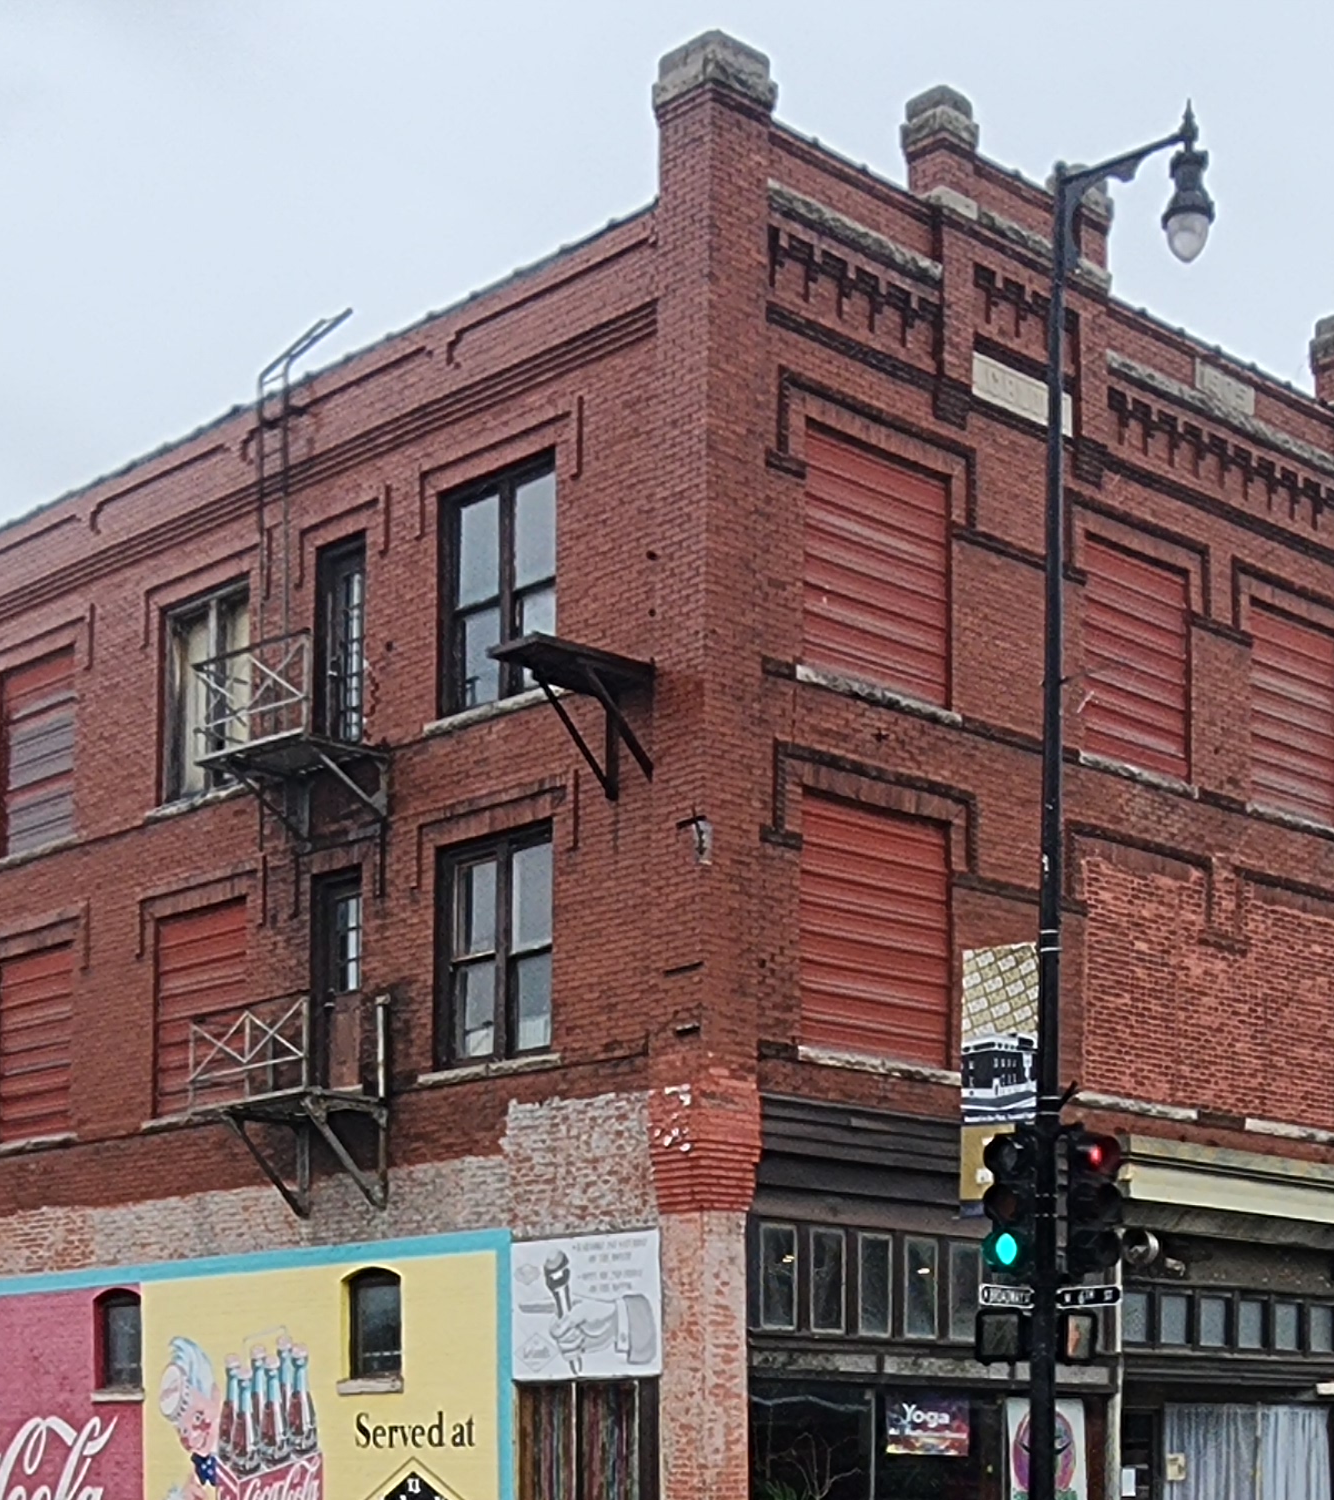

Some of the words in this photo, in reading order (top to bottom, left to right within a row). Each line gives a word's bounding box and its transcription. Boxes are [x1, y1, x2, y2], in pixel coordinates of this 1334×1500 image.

[355, 1410, 446, 1449] Served
[451, 1414, 476, 1448] at
[902, 1402, 950, 1428] Yoga
